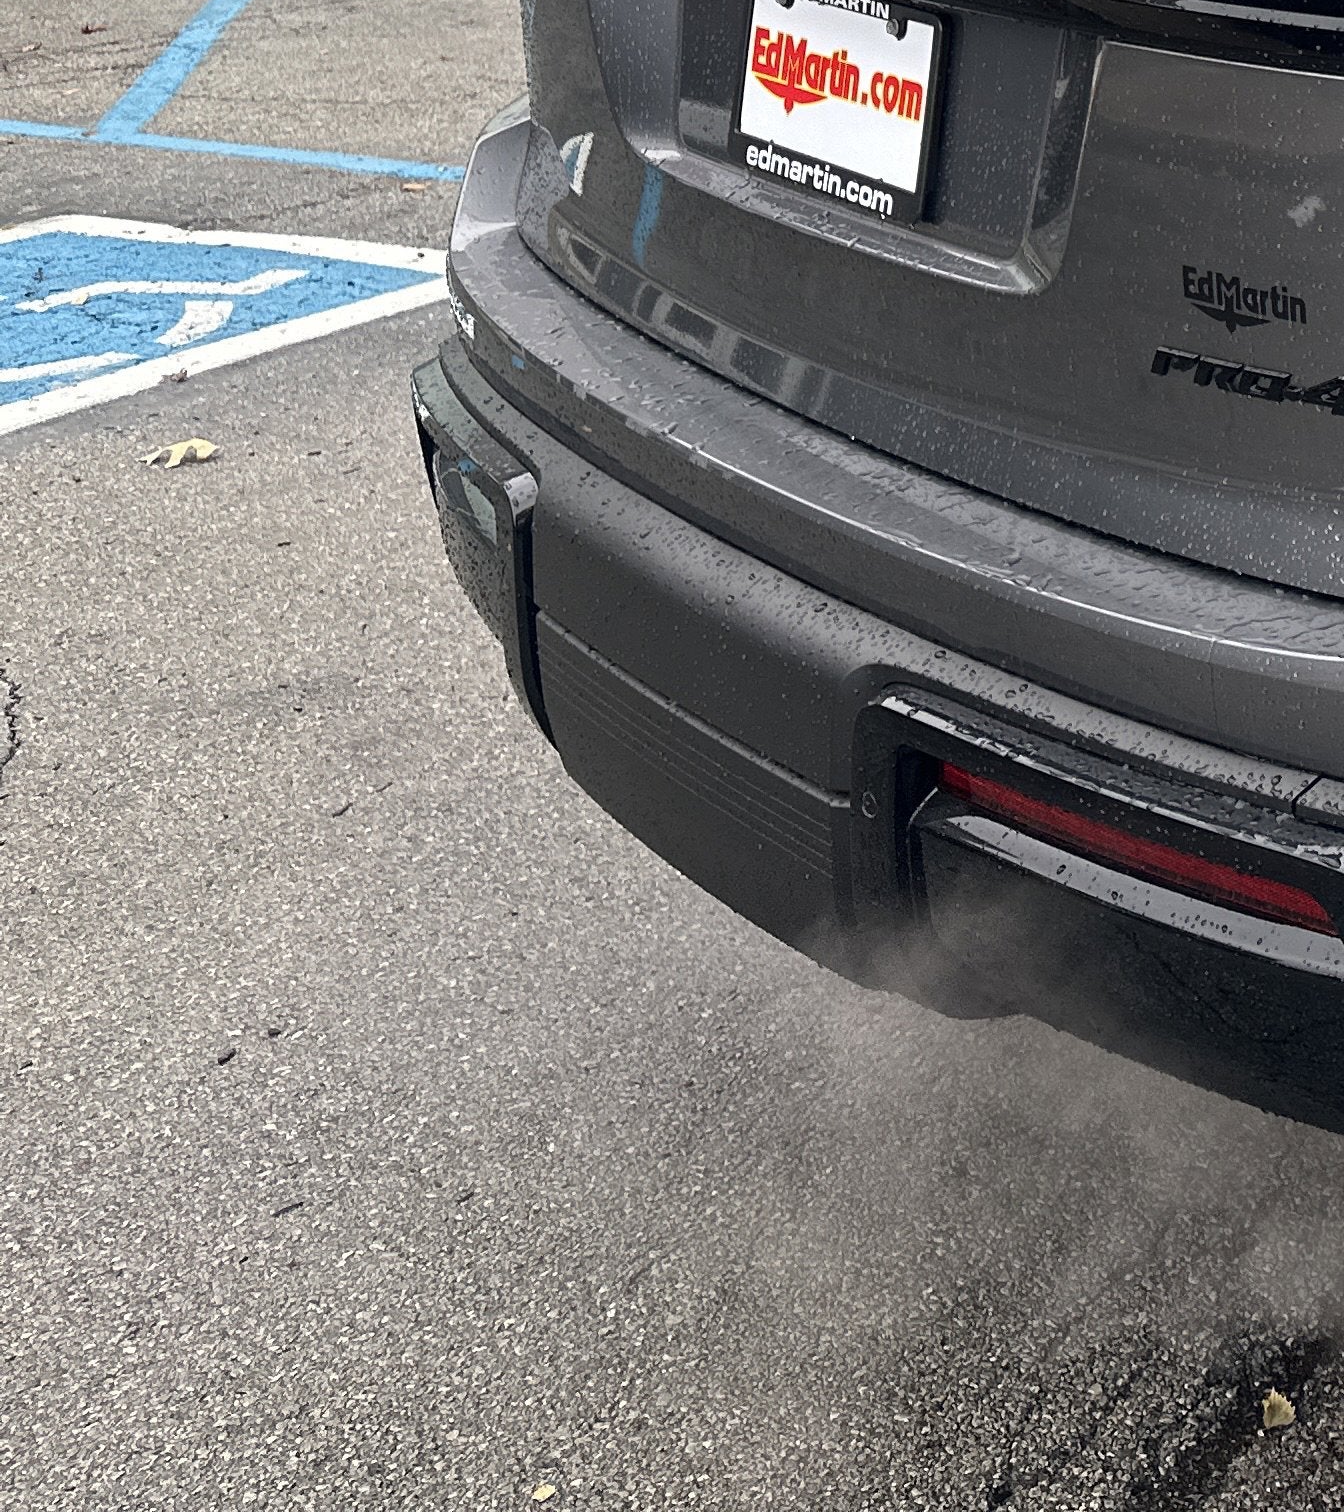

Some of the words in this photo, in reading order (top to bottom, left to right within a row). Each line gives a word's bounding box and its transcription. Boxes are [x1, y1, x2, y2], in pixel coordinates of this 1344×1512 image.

[751, 25, 923, 122] EdMartin.com
[746, 143, 893, 217] edmartin.com
[1182, 264, 1307, 325] EdMartin
